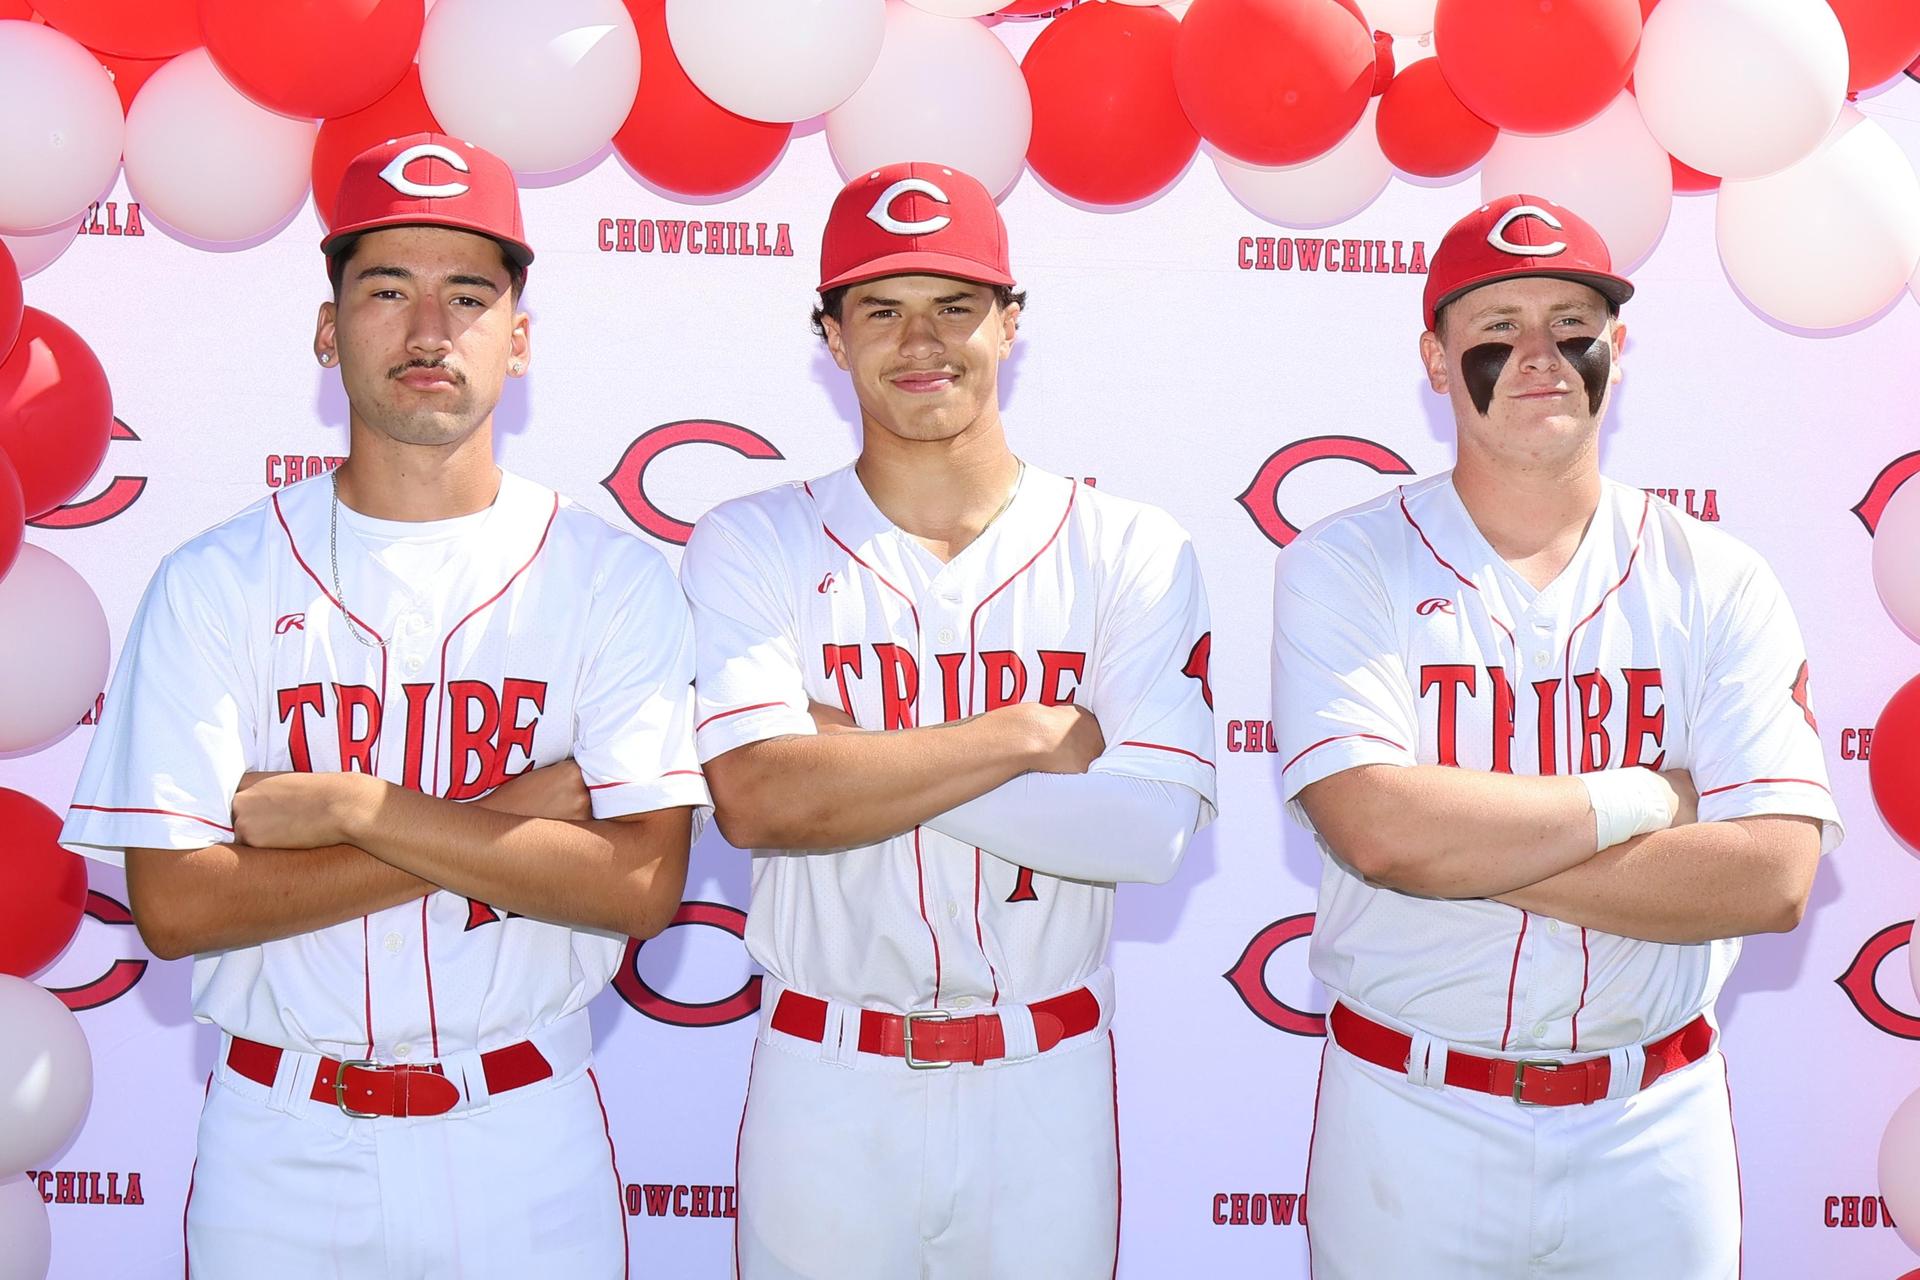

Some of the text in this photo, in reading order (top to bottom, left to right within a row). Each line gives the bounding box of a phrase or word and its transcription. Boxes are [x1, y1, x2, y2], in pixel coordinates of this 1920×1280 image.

[378, 144, 471, 199] C
[77, 201, 145, 236] LLA
[865, 177, 952, 236] C
[598, 218, 794, 256] CHOWCHILLA
[1486, 205, 1567, 257] C
[1238, 237, 1428, 274] CHOWCHILLA
[277, 677, 548, 801] TRIBE
[25, 1171, 145, 1205] CHILLA
